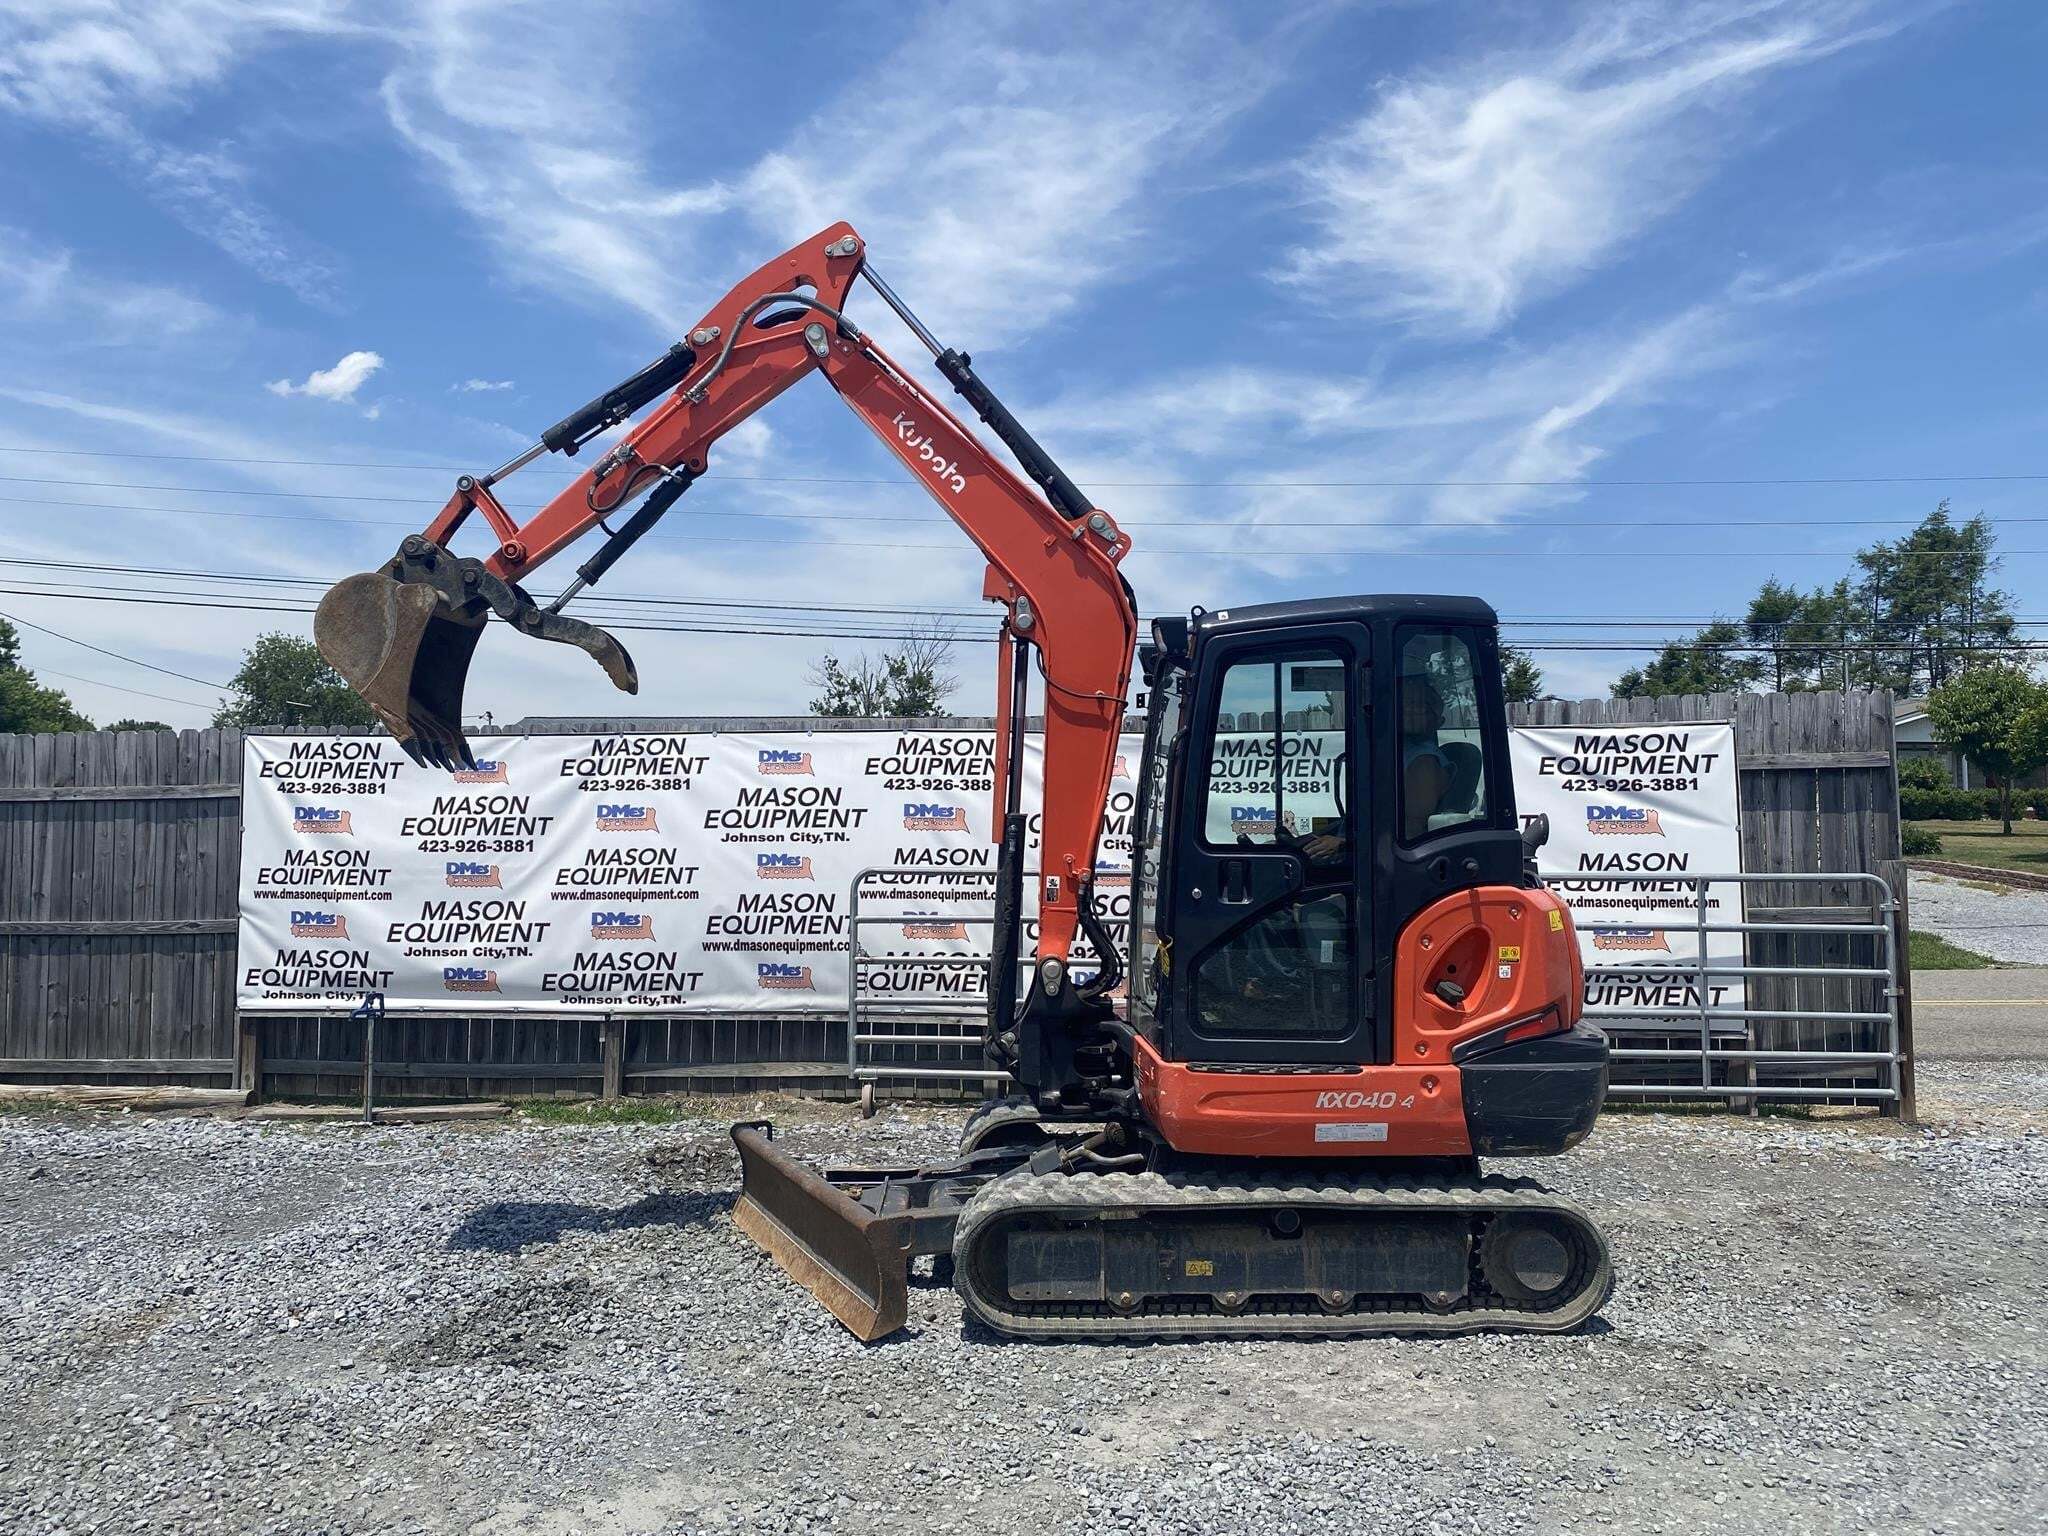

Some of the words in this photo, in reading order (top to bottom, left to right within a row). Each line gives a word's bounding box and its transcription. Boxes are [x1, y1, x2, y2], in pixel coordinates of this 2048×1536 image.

[892, 410, 966, 494] Kubota
[289, 742, 382, 760] MASON
[591, 737, 687, 757] MASON
[896, 737, 996, 756] MASON
[1221, 738, 1323, 758] MASON
[1574, 733, 1689, 754] MASON
[259, 761, 404, 779] EQUIPMENT
[560, 757, 709, 777] EQUIPMENT
[865, 757, 996, 775] EQUIPMEN
[1210, 759, 1334, 778] QUIPMEN
[1539, 754, 1718, 775] EQUIPMENT
[277, 782, 386, 794] 423-926-3881
[578, 778, 691, 791] 423-926-3881
[884, 779, 994, 791] 423-926-388
[1562, 778, 1699, 792] 423-926-3881
[432, 796, 530, 815] MASON
[737, 787, 842, 807] MASON
[704, 809, 868, 829] EQUIPMENT
[1231, 806, 1276, 820] DMe
[400, 817, 553, 836] EQUIPMENT
[418, 840, 534, 853] 423-926-3881
[721, 832, 785, 842] Johnson
[790, 832, 850, 844] City,TN.
[283, 849, 370, 867] MASON
[584, 848, 677, 866] MASON
[893, 848, 989, 866] MASON
[1578, 853, 1688, 872] MASON
[258, 868, 391, 886] EQUIPMENT
[555, 867, 699, 885] EQUIPMENT
[864, 873, 996, 885] EQUIPMEN
[254, 889, 392, 902] www.dmasonequipment.com
[551, 889, 699, 902] www.dmasonequipment.com
[737, 893, 836, 913] MASON
[860, 888, 996, 902] www.dmasonequipment.c
[421, 900, 526, 921] MASON
[387, 922, 551, 943] EQUIPMENT
[403, 947, 468, 957] Johnson
[472, 947, 533, 959] City,TN.
[702, 939, 850, 954] www.dmasonequipment.co
[275, 949, 370, 969] MASON
[573, 952, 677, 971] MASON
[885, 952, 991, 971] MASON
[245, 969, 394, 988] EQUIPMENT
[541, 973, 703, 992] EQUIPMENT
[857, 973, 990, 992] EQUIPME
[262, 991, 320, 1000] Johnson
[325, 991, 367, 1001] City,T
[560, 995, 625, 1005] Johnson
[627, 995, 687, 1006] City,TN.
[1584, 986, 1728, 1006] UIPMENT
[1315, 1091, 1397, 1109] KX040
